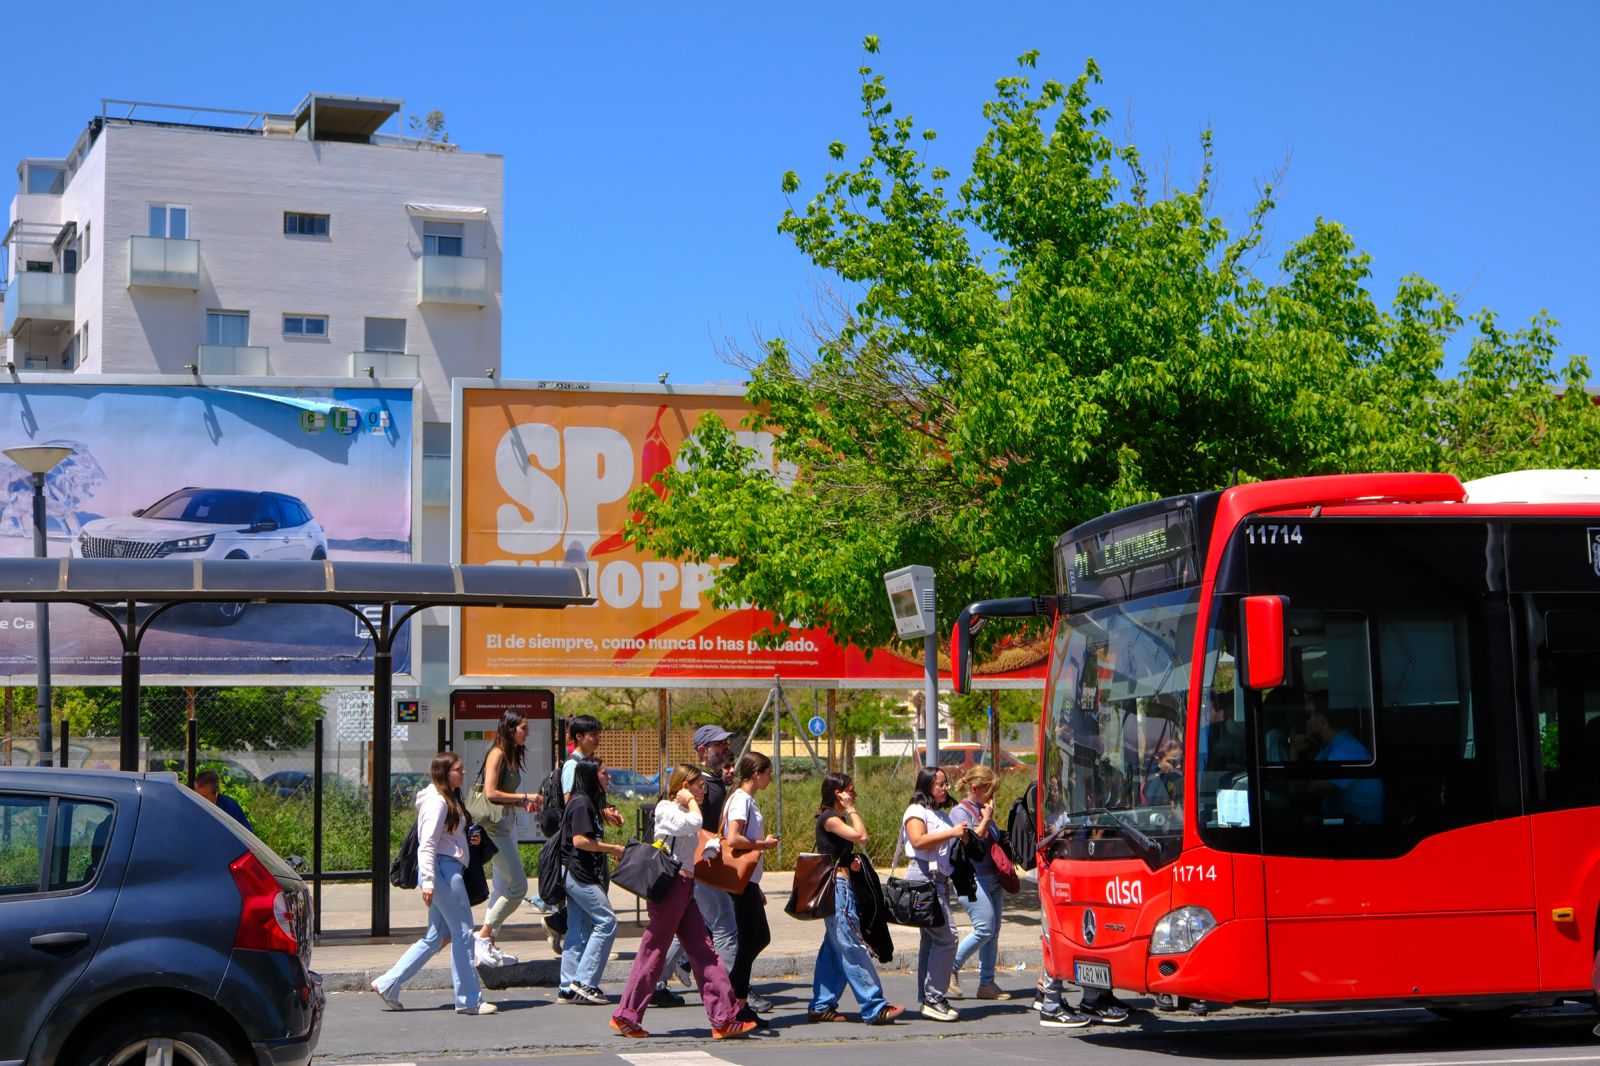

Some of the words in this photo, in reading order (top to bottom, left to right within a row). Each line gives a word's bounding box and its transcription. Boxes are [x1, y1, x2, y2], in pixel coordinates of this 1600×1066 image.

[1245, 524, 1303, 545] 11714
[486, 634, 502, 649] El
[504, 634, 526, 649] de
[528, 633, 599, 652] siempre,
[601, 638, 646, 650] como
[648, 638, 697, 650] nunca
[699, 635, 714, 650] lo
[716, 636, 745, 651] has
[747, 637, 819, 655] pbado.
[1172, 864, 1217, 882] 11714
[1105, 875, 1143, 905] alsa
